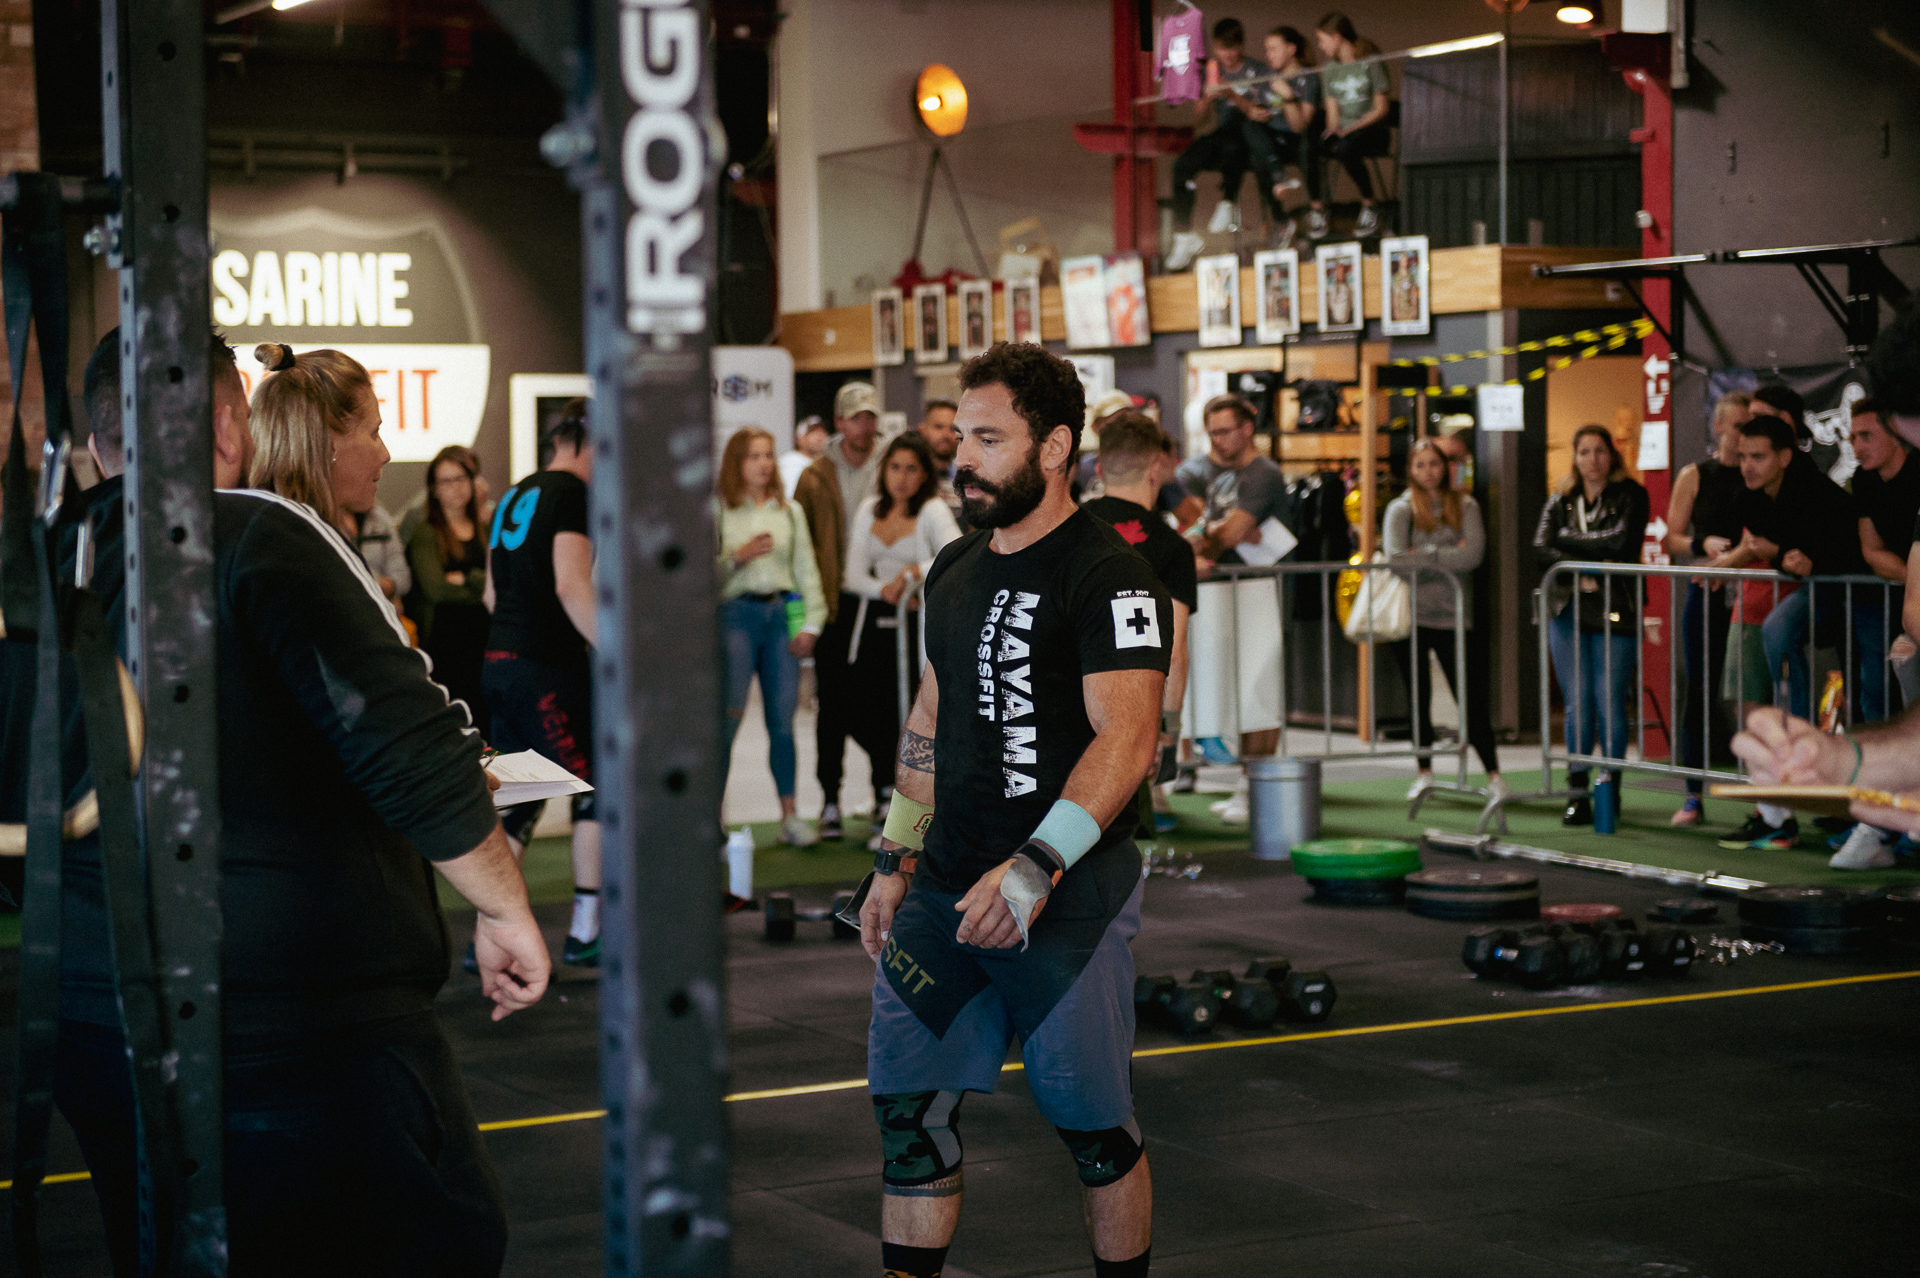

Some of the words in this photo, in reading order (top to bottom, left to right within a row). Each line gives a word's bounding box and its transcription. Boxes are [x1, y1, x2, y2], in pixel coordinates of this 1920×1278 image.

[618, 0, 705, 304] ROG
[212, 250, 414, 327] SARINE
[489, 485, 541, 551] 19
[977, 588, 1010, 722] CROSSFIT
[997, 591, 1041, 799] MAYAMA
[885, 935, 936, 995] SFIT
